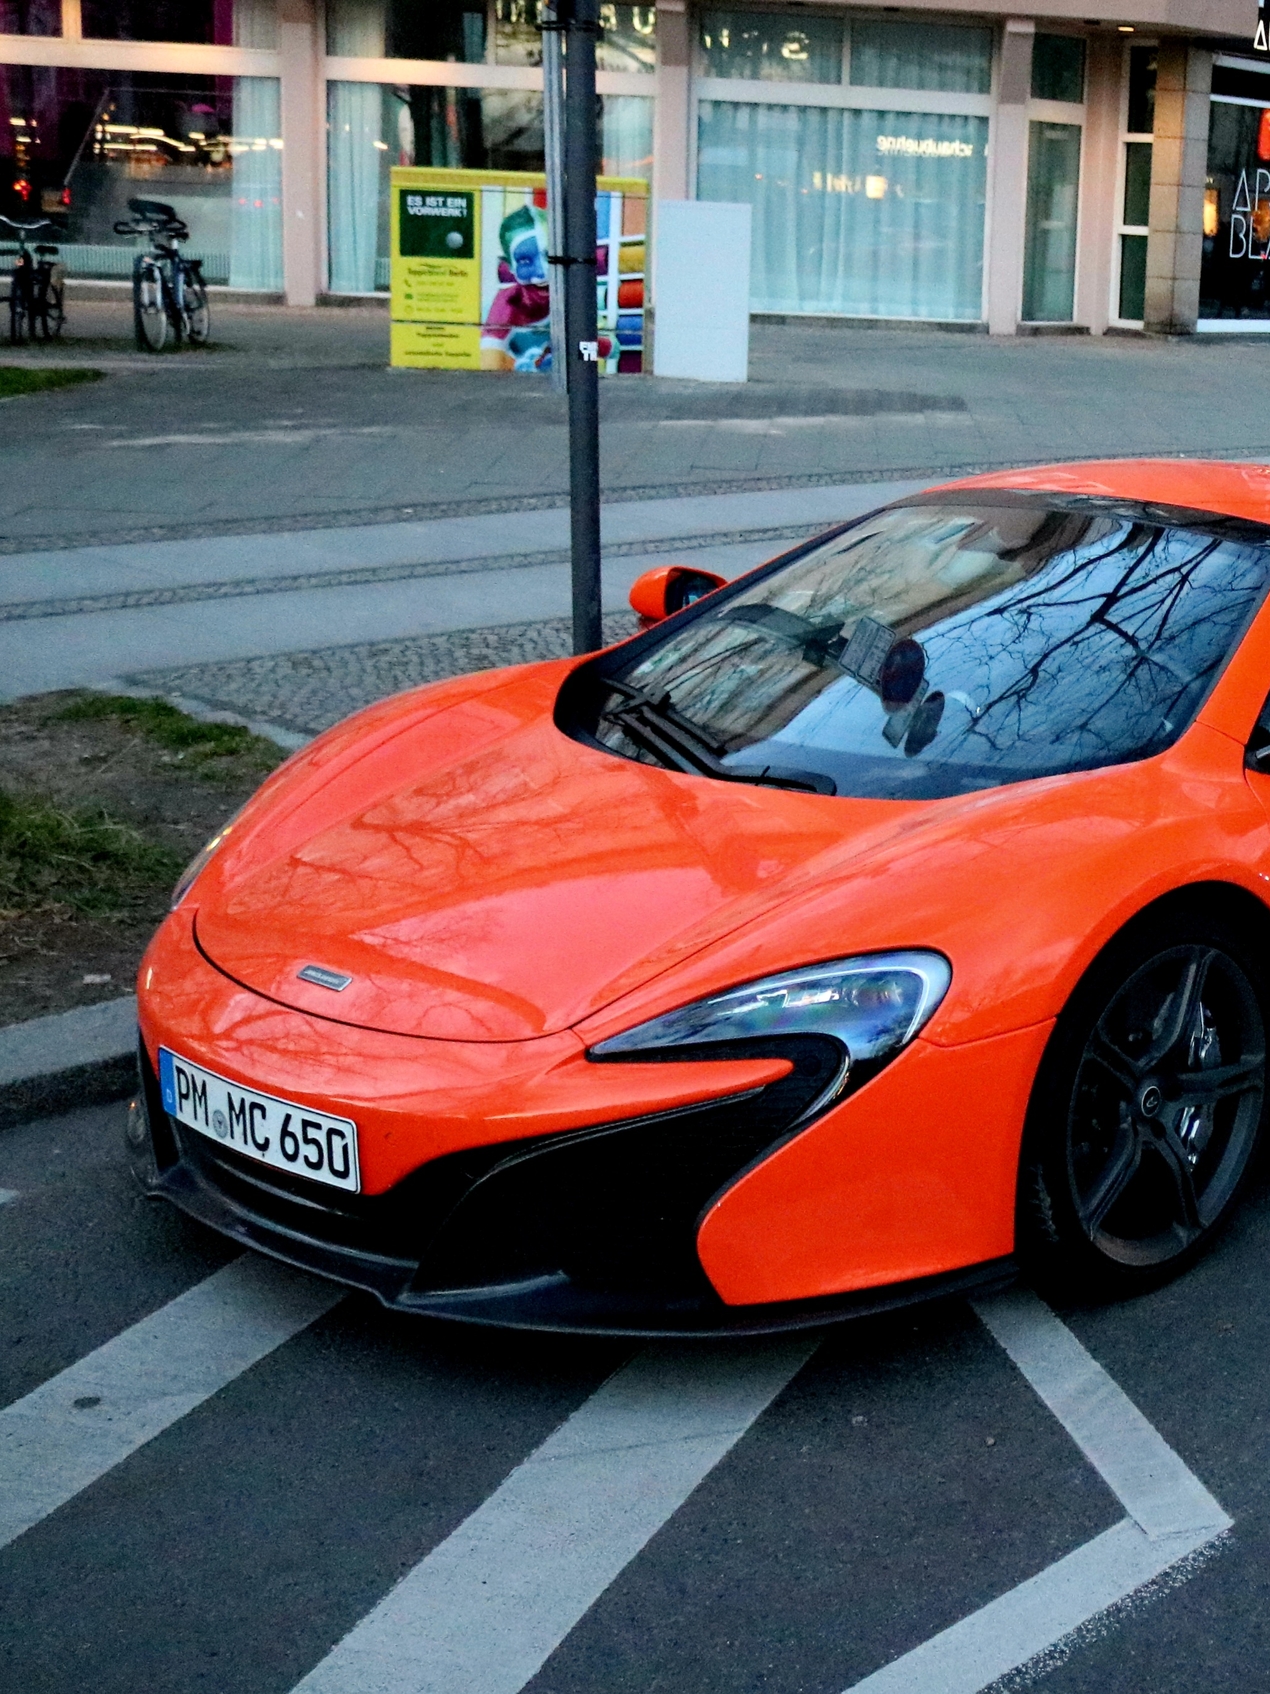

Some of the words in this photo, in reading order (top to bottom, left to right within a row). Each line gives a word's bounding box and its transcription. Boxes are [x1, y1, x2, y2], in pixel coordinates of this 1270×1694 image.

[406, 194, 423, 206] ES
[425, 195, 445, 207] IST
[446, 197, 467, 208] EIN
[175, 1065, 209, 1127] PM
[227, 1091, 271, 1152] MC
[280, 1113, 351, 1180] 650
